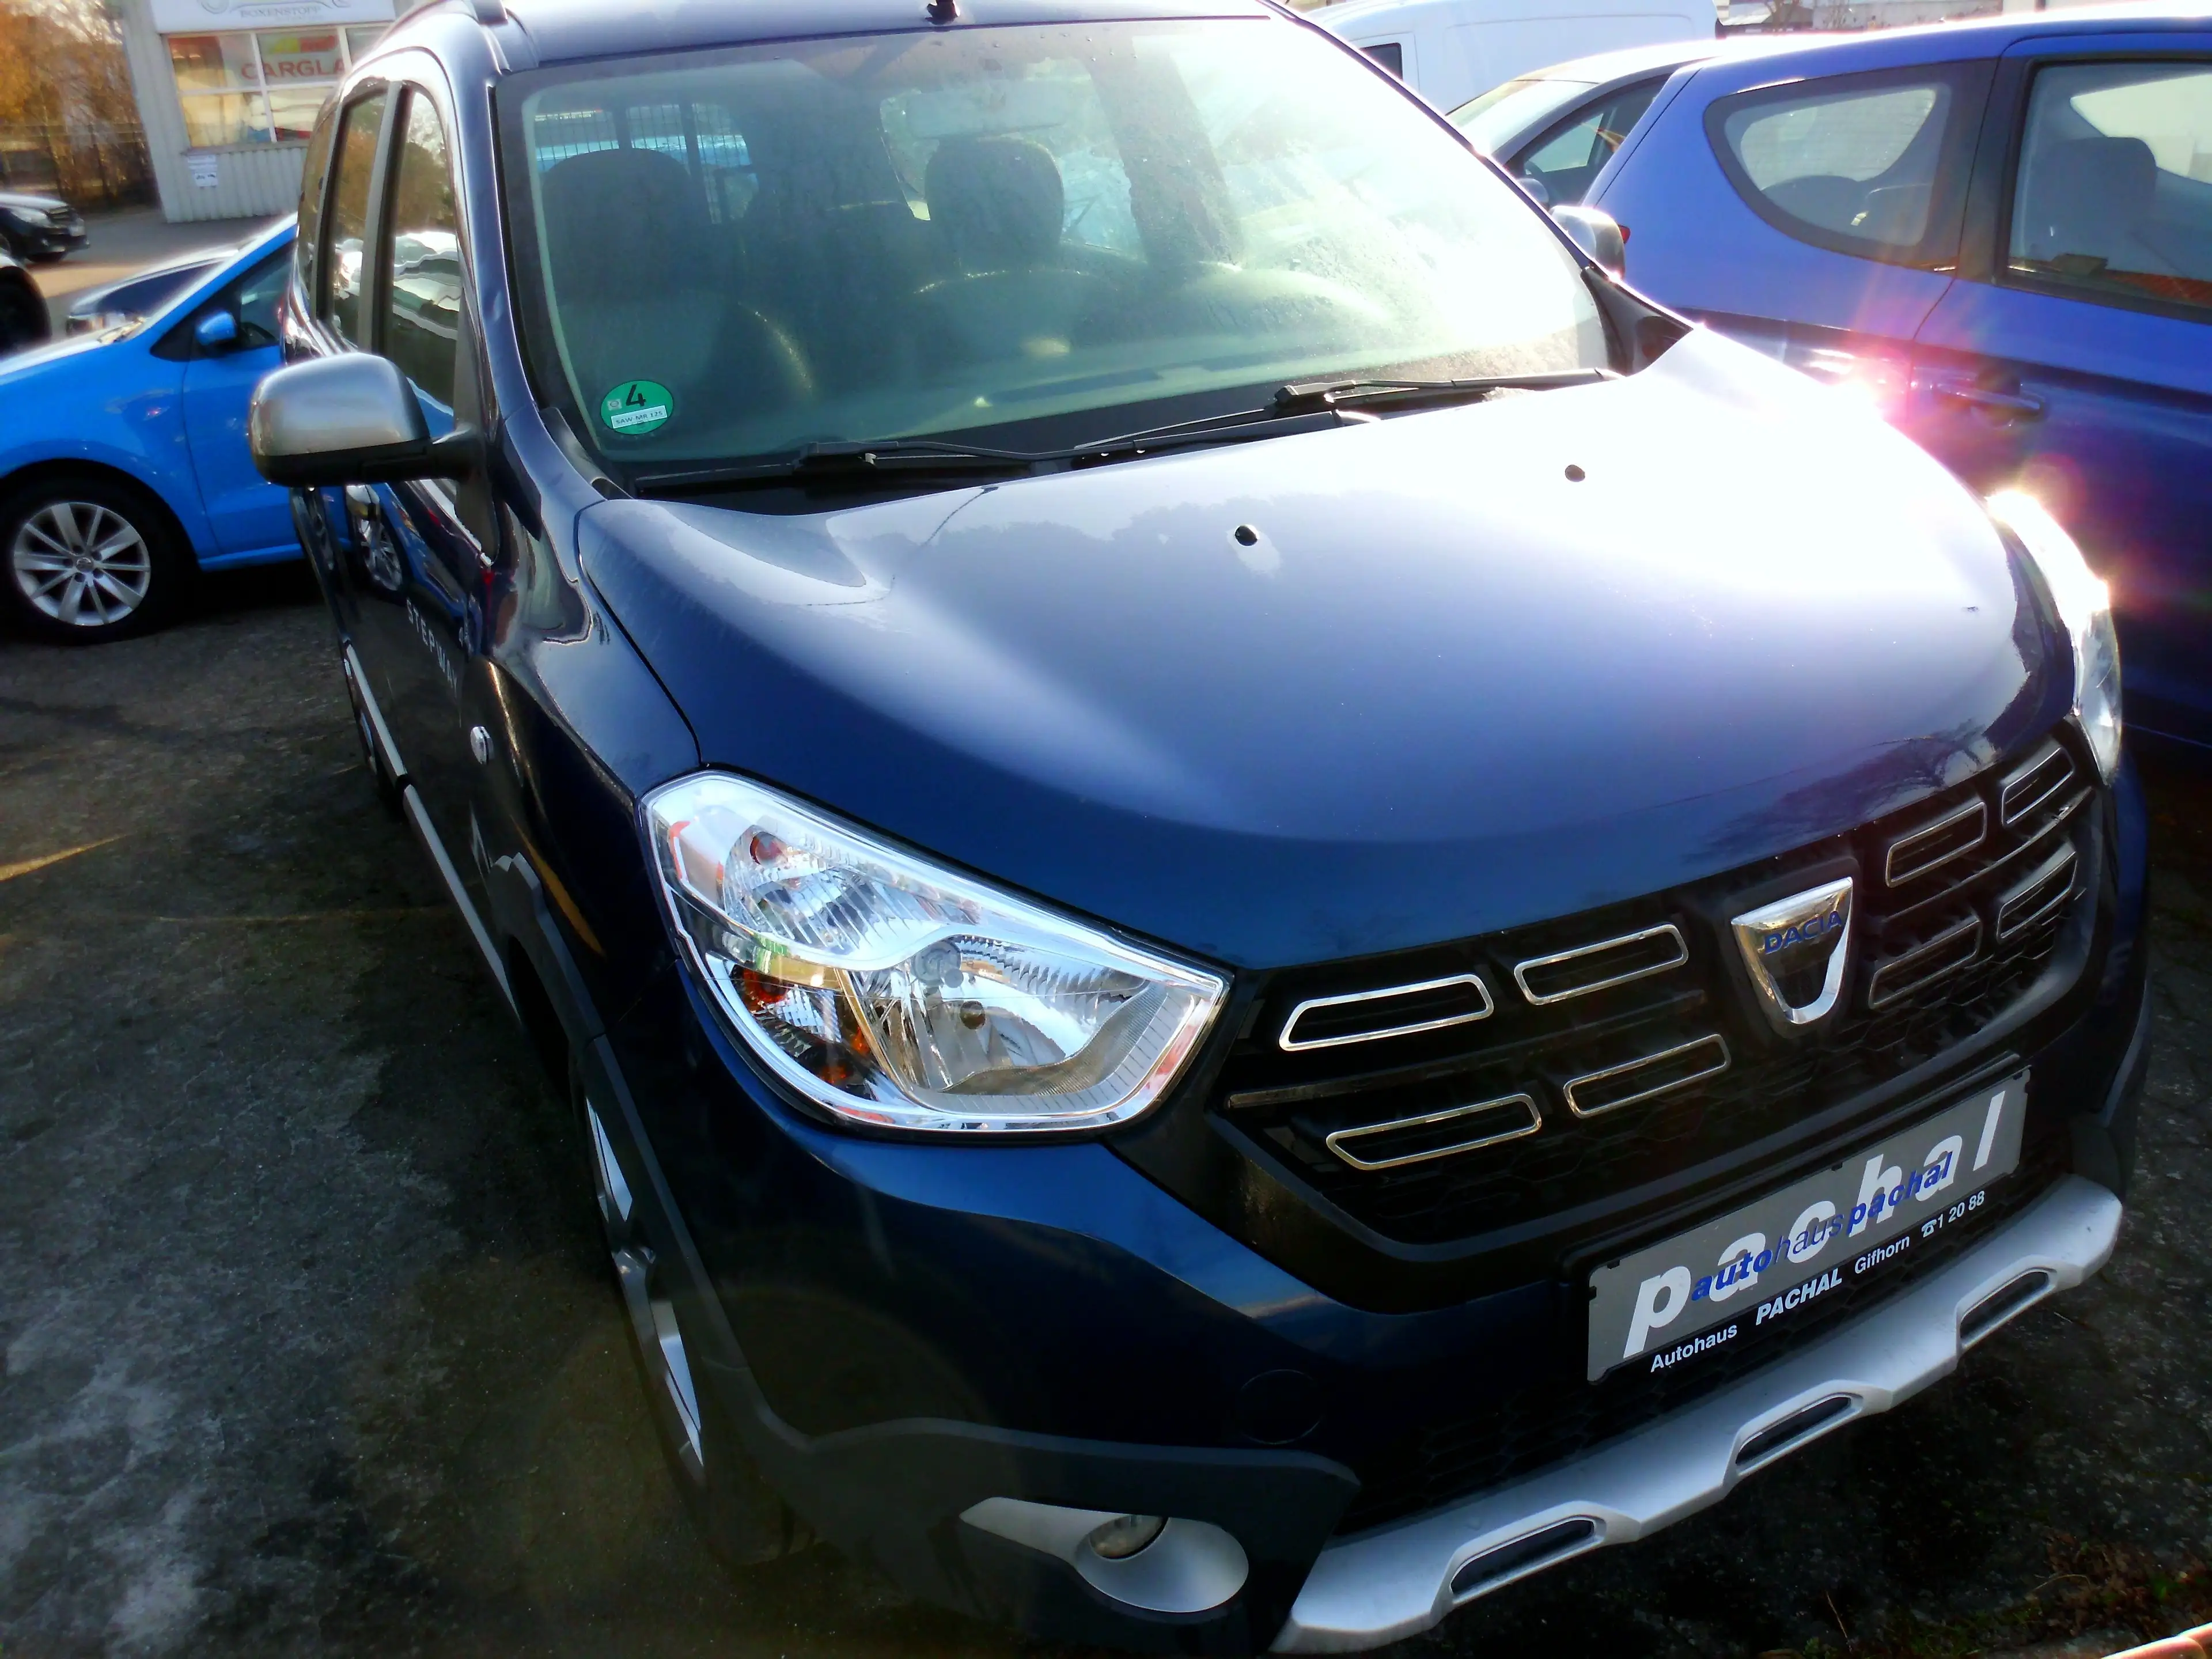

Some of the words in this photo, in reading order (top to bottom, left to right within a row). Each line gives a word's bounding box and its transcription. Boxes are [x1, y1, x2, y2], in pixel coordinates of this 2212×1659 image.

[240, 6, 322, 18] BOXENSTOPP
[626, 384, 646, 406] 4
[616, 416, 633, 425] SAW
[1764, 910, 1842, 954] DACIA
[1650, 1324, 1737, 1373] Autohaus
[1756, 1267, 1842, 1325] PACHAL
[1854, 1236, 1910, 1274] Gifhorn
[1948, 1202, 1965, 1223] 20
[1968, 1191, 1984, 1210] 88
